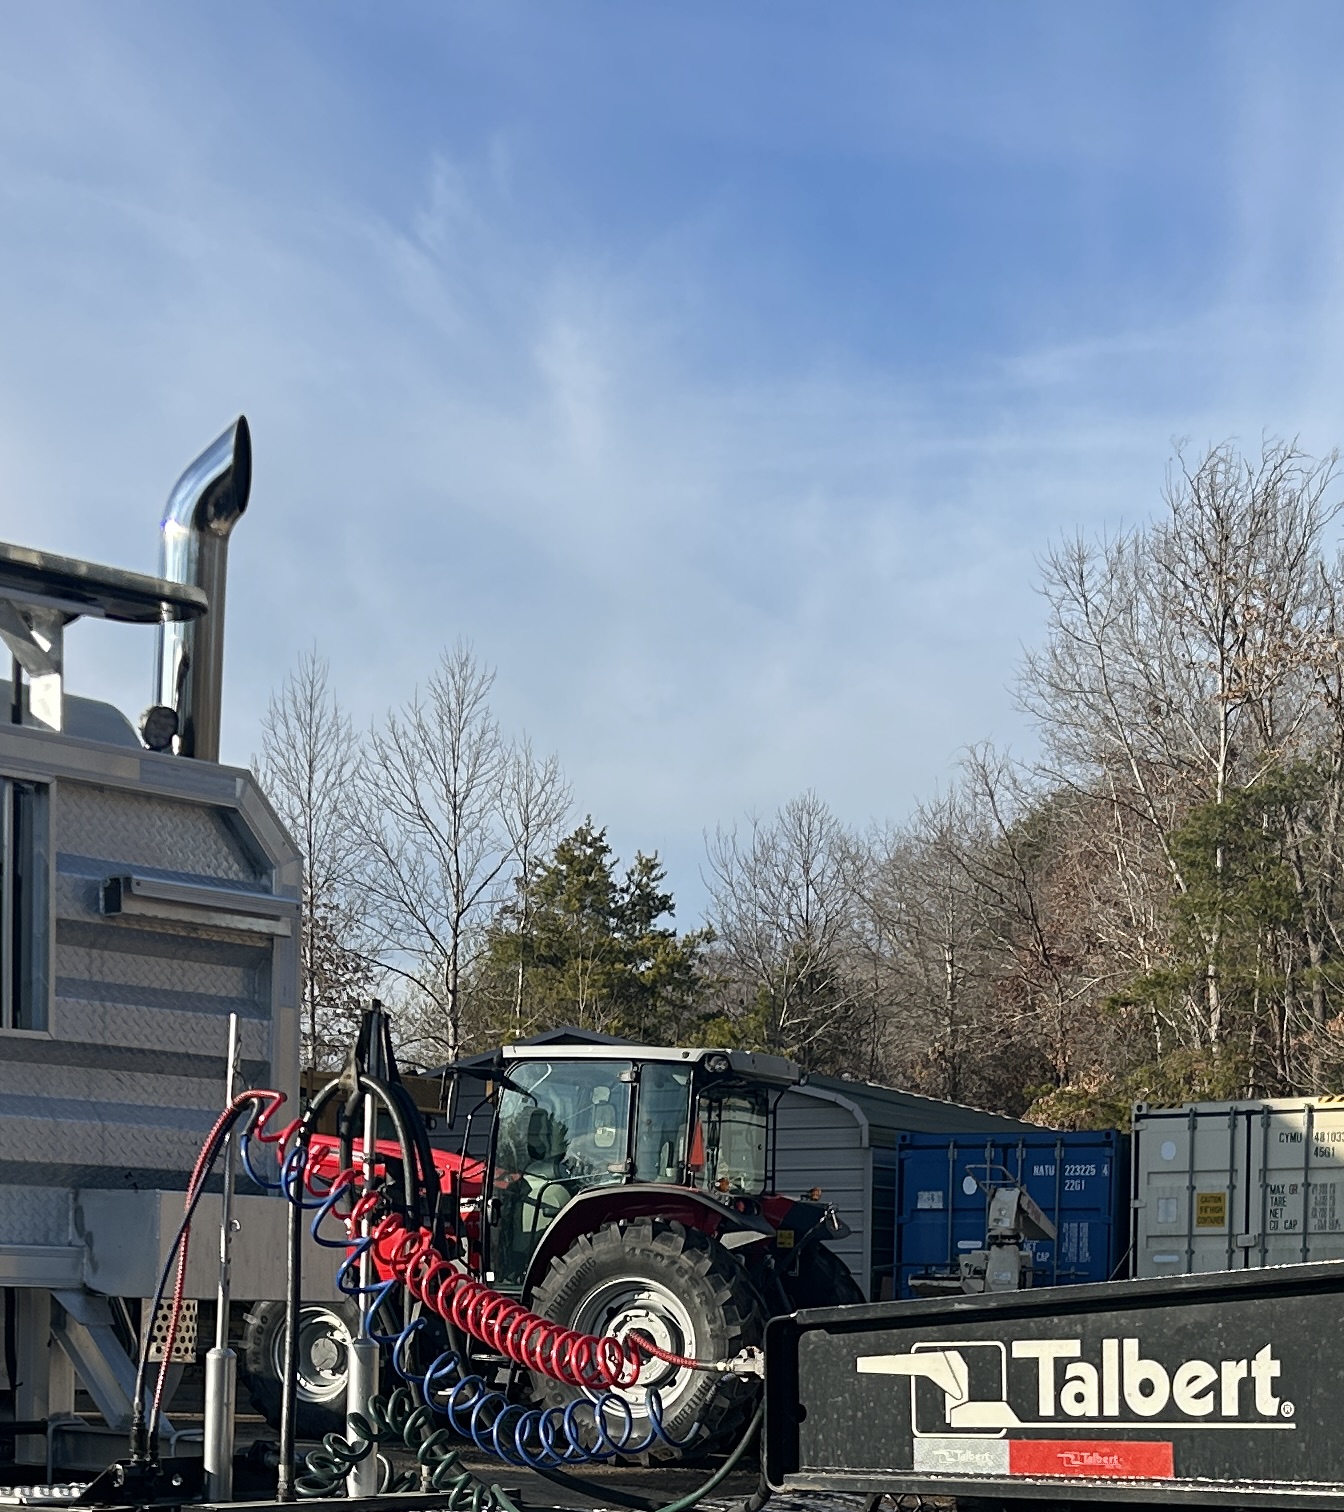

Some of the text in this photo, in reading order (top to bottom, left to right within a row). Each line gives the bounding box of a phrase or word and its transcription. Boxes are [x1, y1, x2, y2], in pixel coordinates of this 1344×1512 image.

[1278, 1132, 1303, 1143] CYMU
[1313, 1146, 1335, 1158] 45G1
[1064, 1164, 1097, 1176] 223225
[1102, 1164, 1109, 1176] 4
[1064, 1179, 1086, 1191] 22G1
[1269, 1184, 1285, 1195] MAX
[1269, 1196, 1287, 1207] TARE
[1269, 1208, 1284, 1219] NET
[1283, 1219, 1298, 1230] CAP
[1036, 1252, 1050, 1262] CAP
[544, 1256, 598, 1318] TRELLEBORG
[1011, 1338, 1282, 1417] Talbert
[664, 1375, 716, 1436] TRELLEBOR
[1080, 1452, 1119, 1465] Talbert
